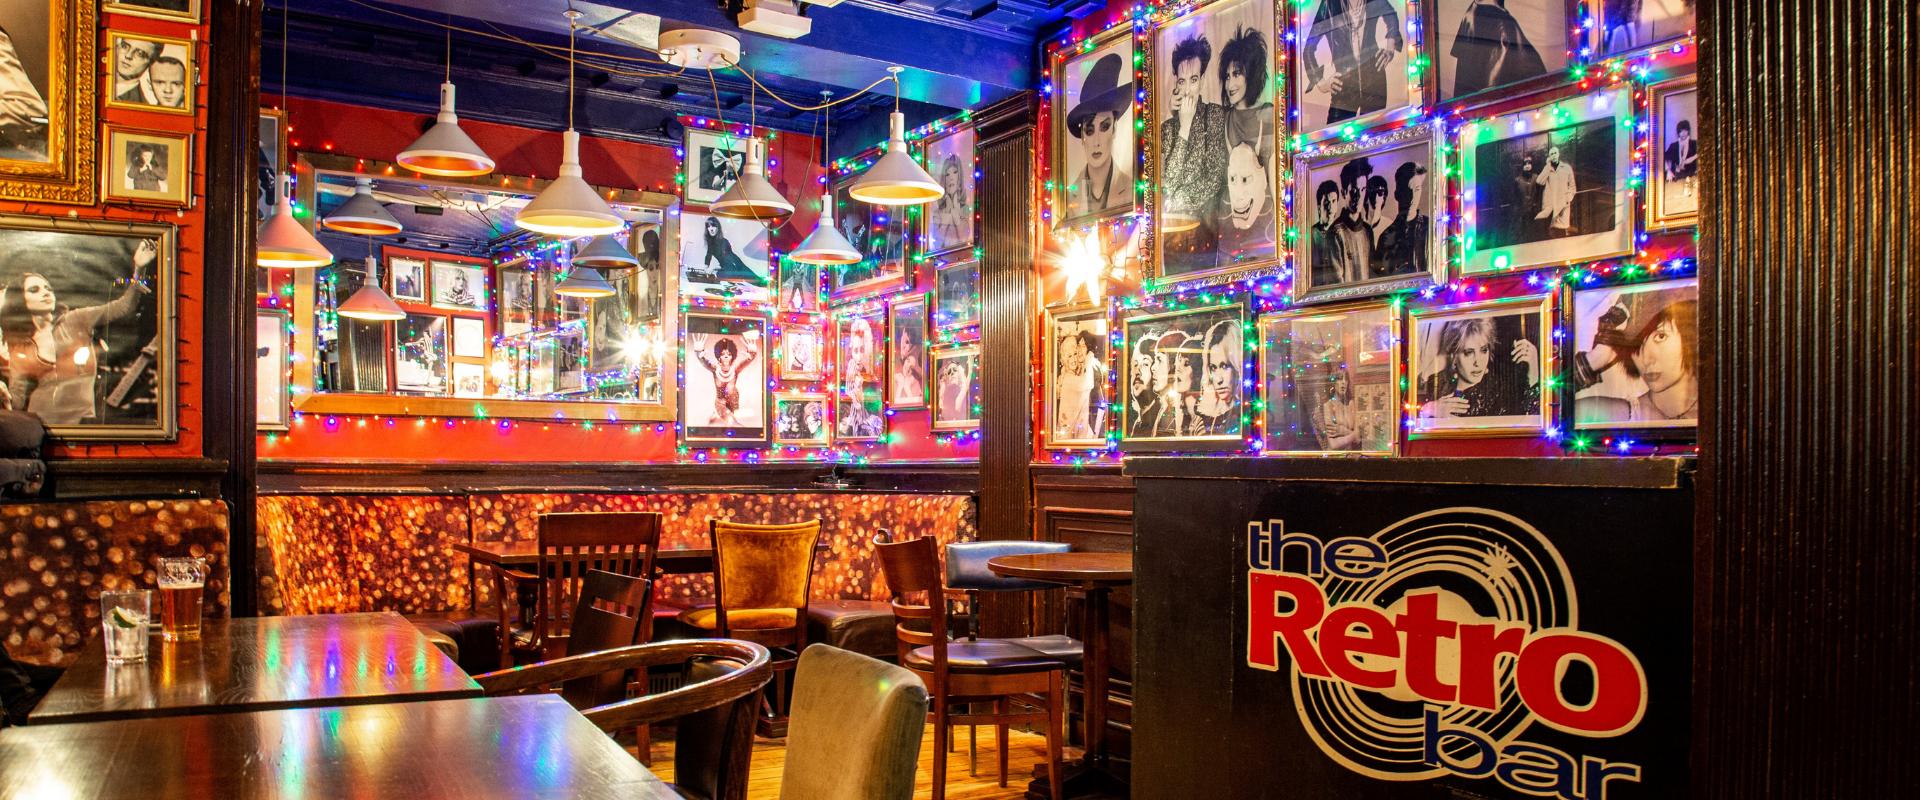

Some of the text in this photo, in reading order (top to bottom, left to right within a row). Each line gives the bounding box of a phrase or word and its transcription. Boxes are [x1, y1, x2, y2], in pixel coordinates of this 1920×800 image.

[1248, 519, 1388, 579] the
[1247, 569, 1647, 737] Retro
[1424, 704, 1641, 800] bar
